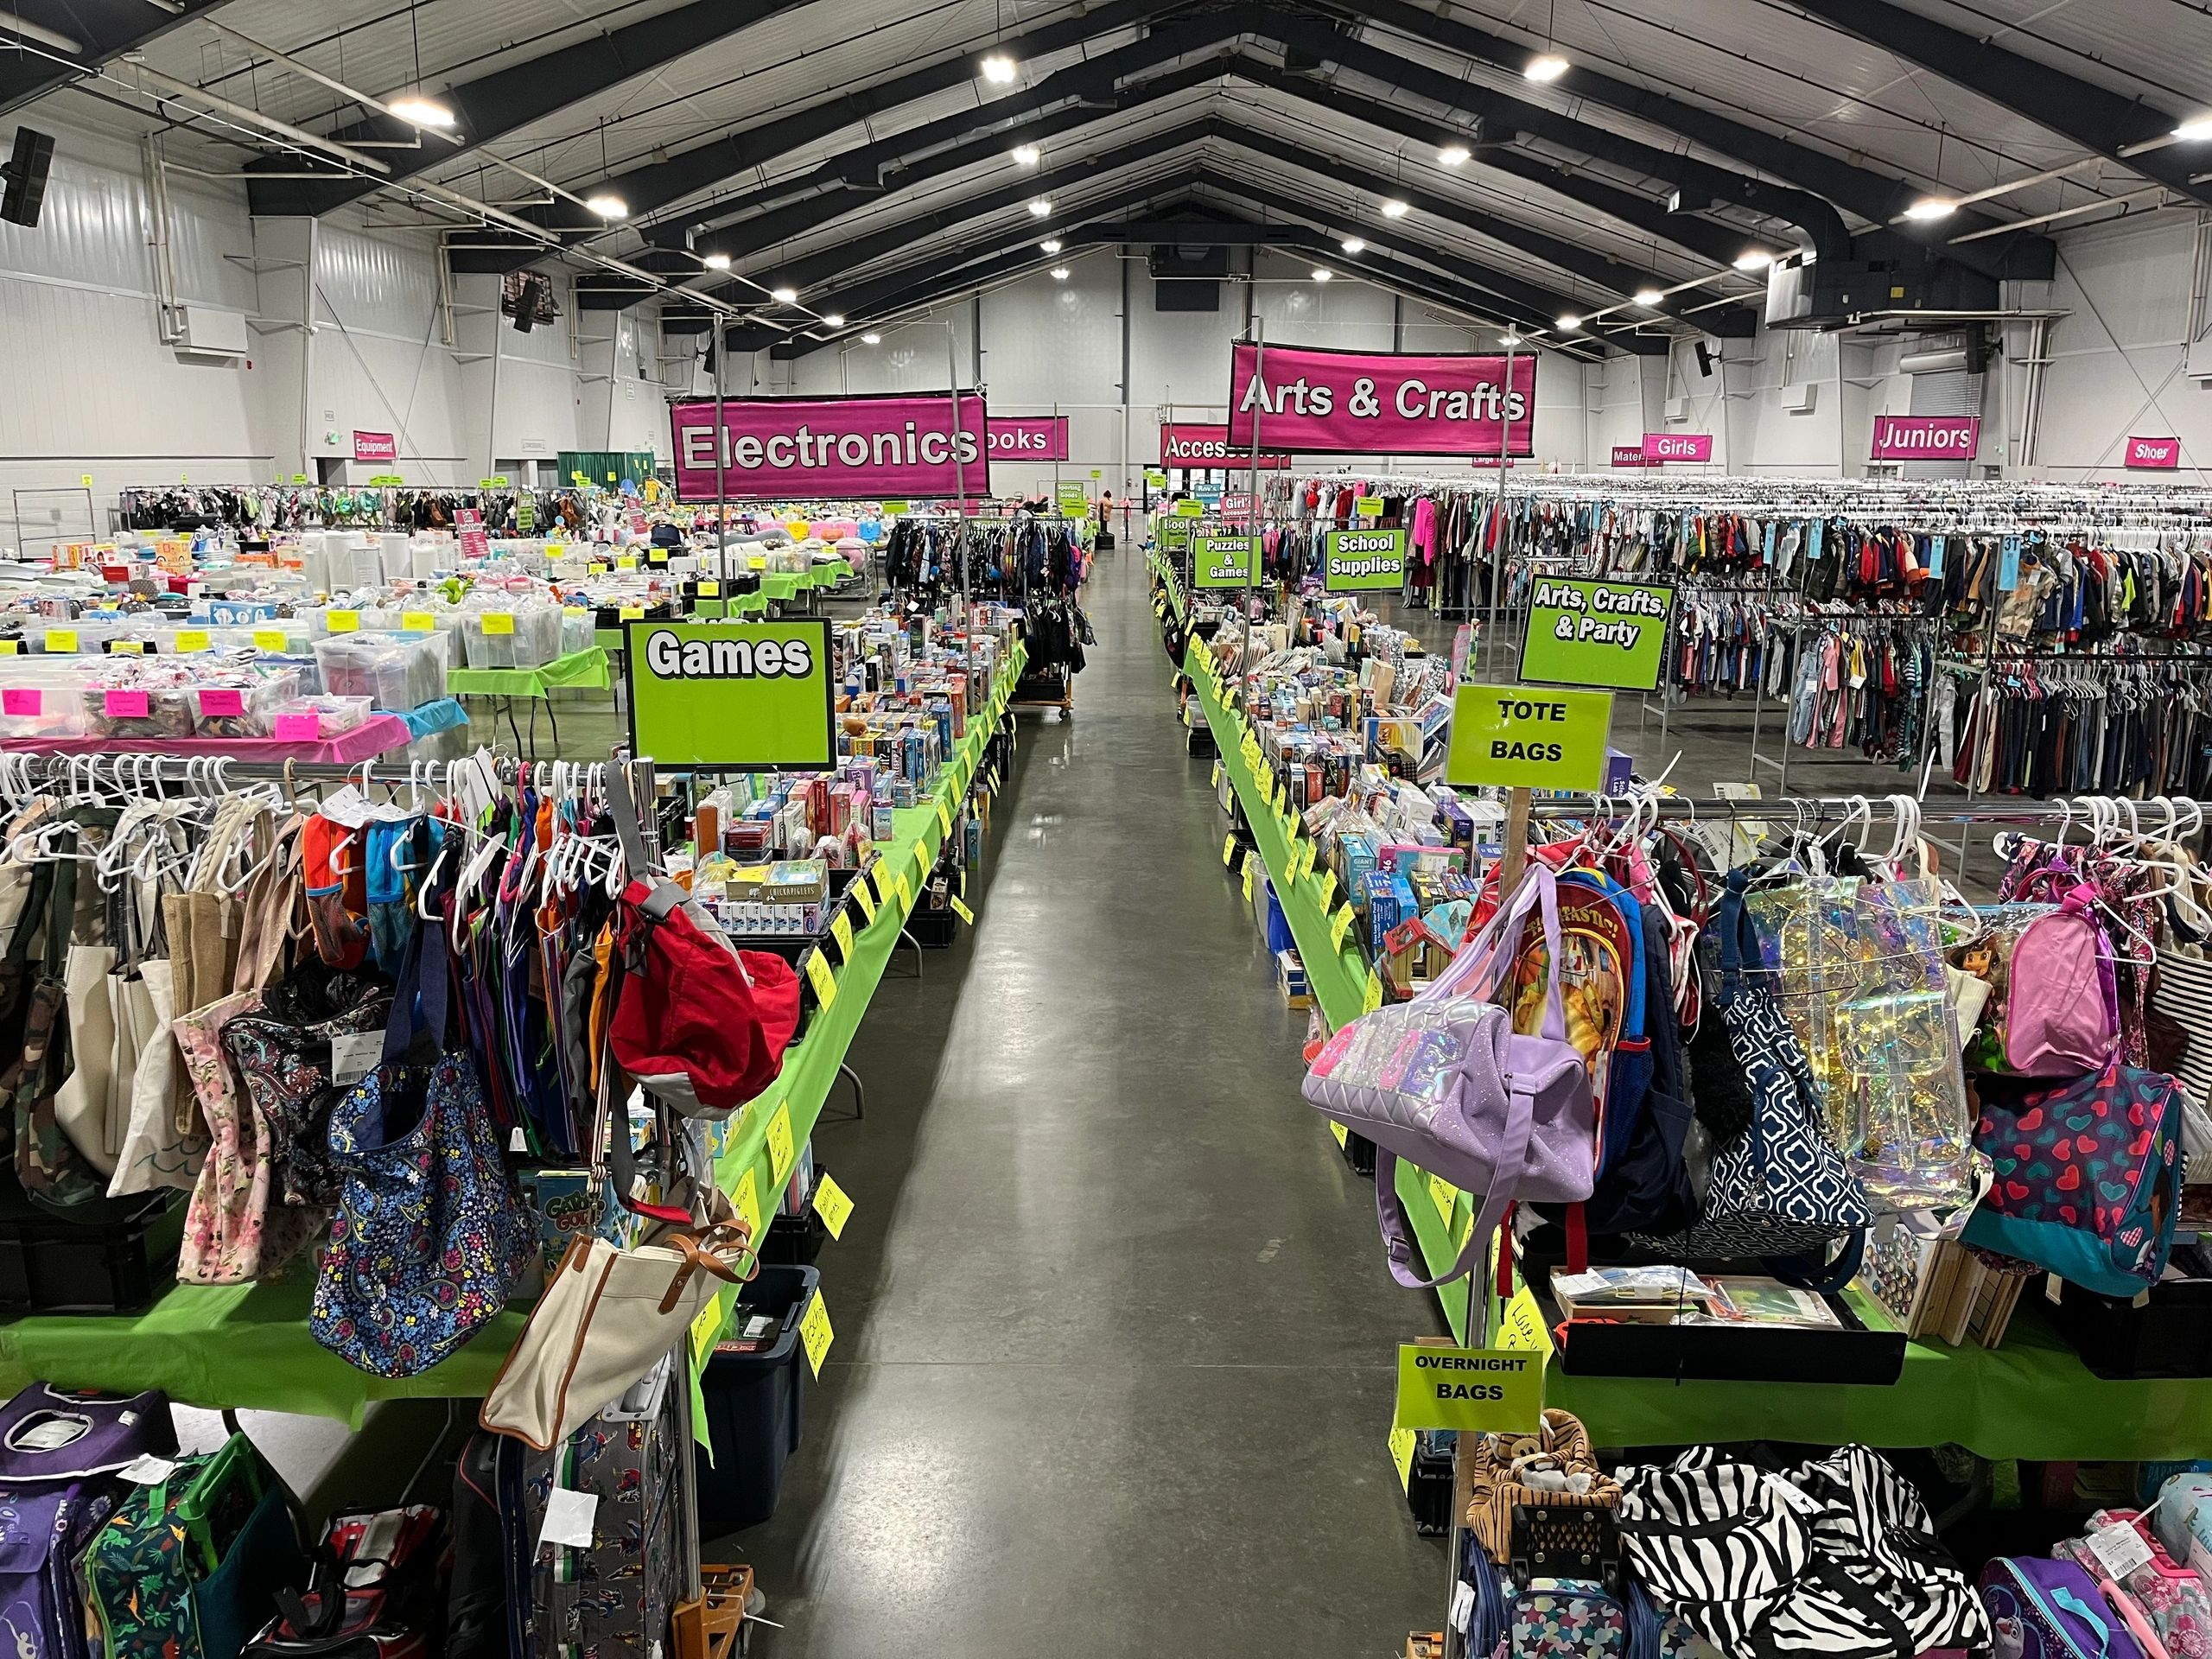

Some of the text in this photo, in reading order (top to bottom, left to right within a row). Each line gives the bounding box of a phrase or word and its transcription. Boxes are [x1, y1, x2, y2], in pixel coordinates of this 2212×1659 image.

[1239, 374, 1526, 421] Arts & Crafts
[680, 421, 980, 469] Electronics
[987, 428, 1047, 450] ooks
[1878, 423, 1971, 449] Juniors
[355, 438, 394, 455] Equipment
[1657, 439, 1697, 455] Girls
[2134, 443, 2171, 460] Shoes
[1206, 539, 1249, 551] Puzzles
[1338, 533, 1394, 552] School
[2004, 537, 2020, 551] 3T
[1223, 554, 1234, 567] &
[1329, 556, 1401, 576] Supplies
[1209, 566, 1249, 578] Games
[1535, 582, 1667, 619] Arts, Crafts,
[1554, 615, 1640, 647] & Party
[645, 630, 810, 676] Games
[1497, 699, 1567, 721] TOTE
[1490, 740, 1563, 762] BAGS
[556, 1211, 601, 1231] GOL
[1414, 1355, 1528, 1372] OVERNIGHT
[1436, 1382, 1503, 1401] BAGS
